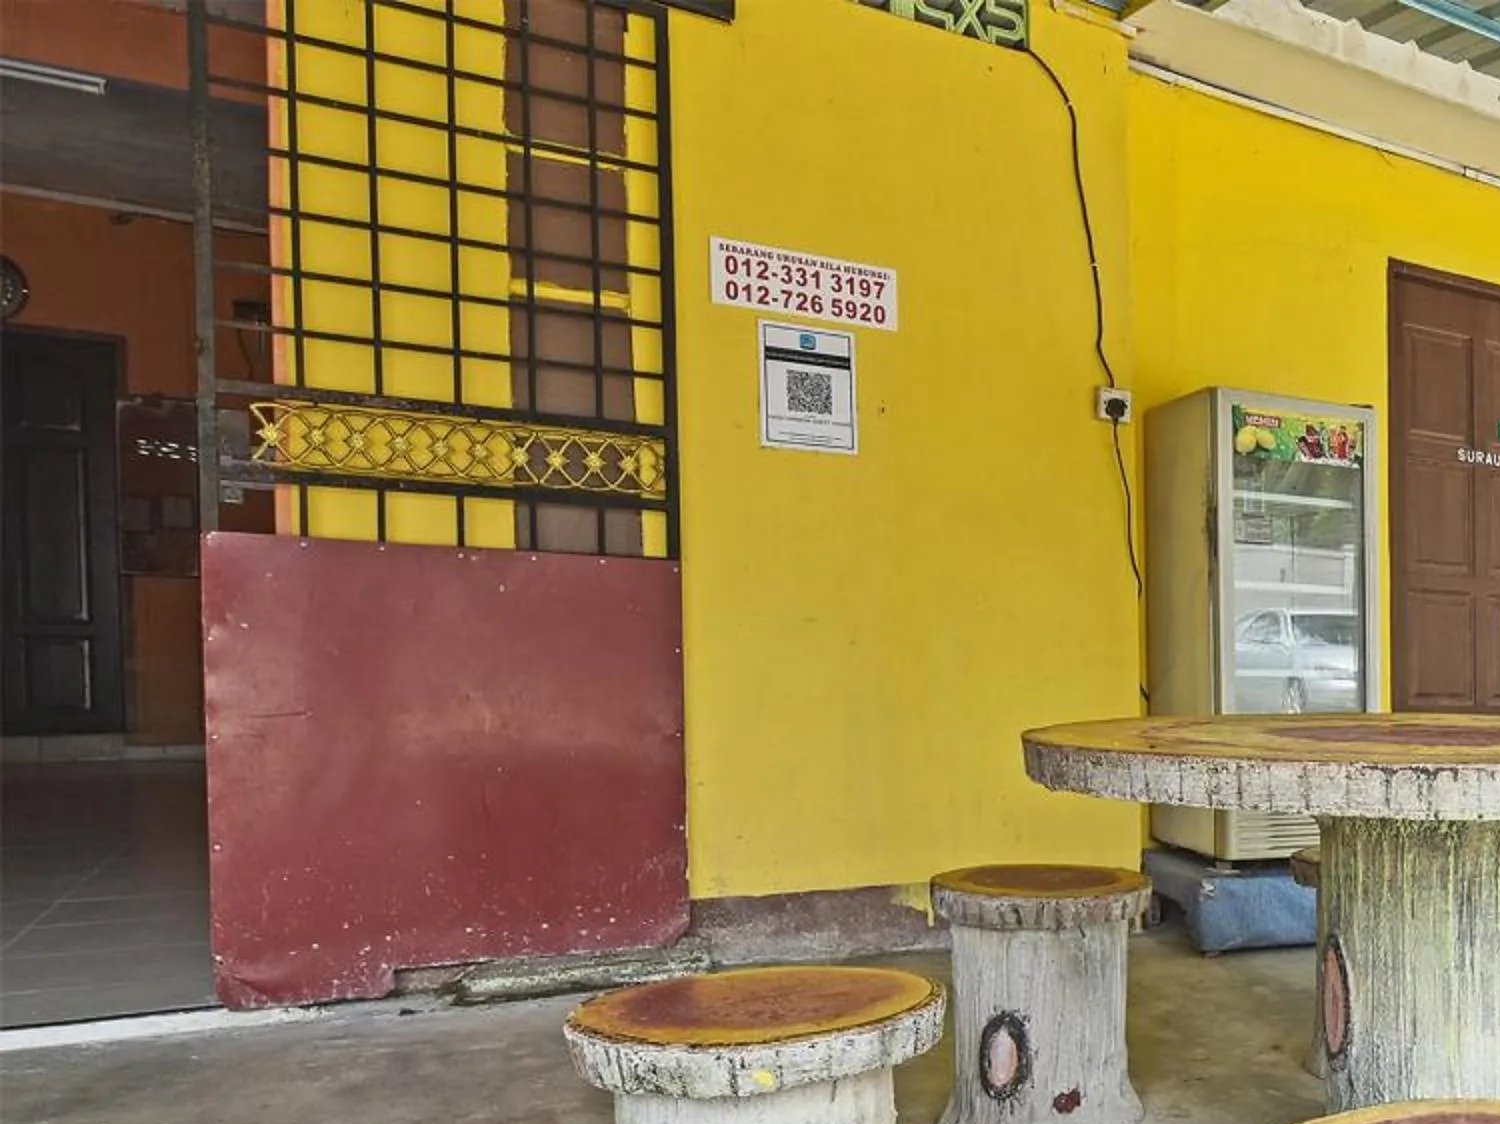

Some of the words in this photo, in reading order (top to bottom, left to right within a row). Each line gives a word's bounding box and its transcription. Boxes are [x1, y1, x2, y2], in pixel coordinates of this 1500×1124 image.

[725, 255, 822, 290] 012-331
[830, 274, 886, 300] 3197
[725, 281, 824, 314] 012-726
[831, 298, 886, 324] 5920
